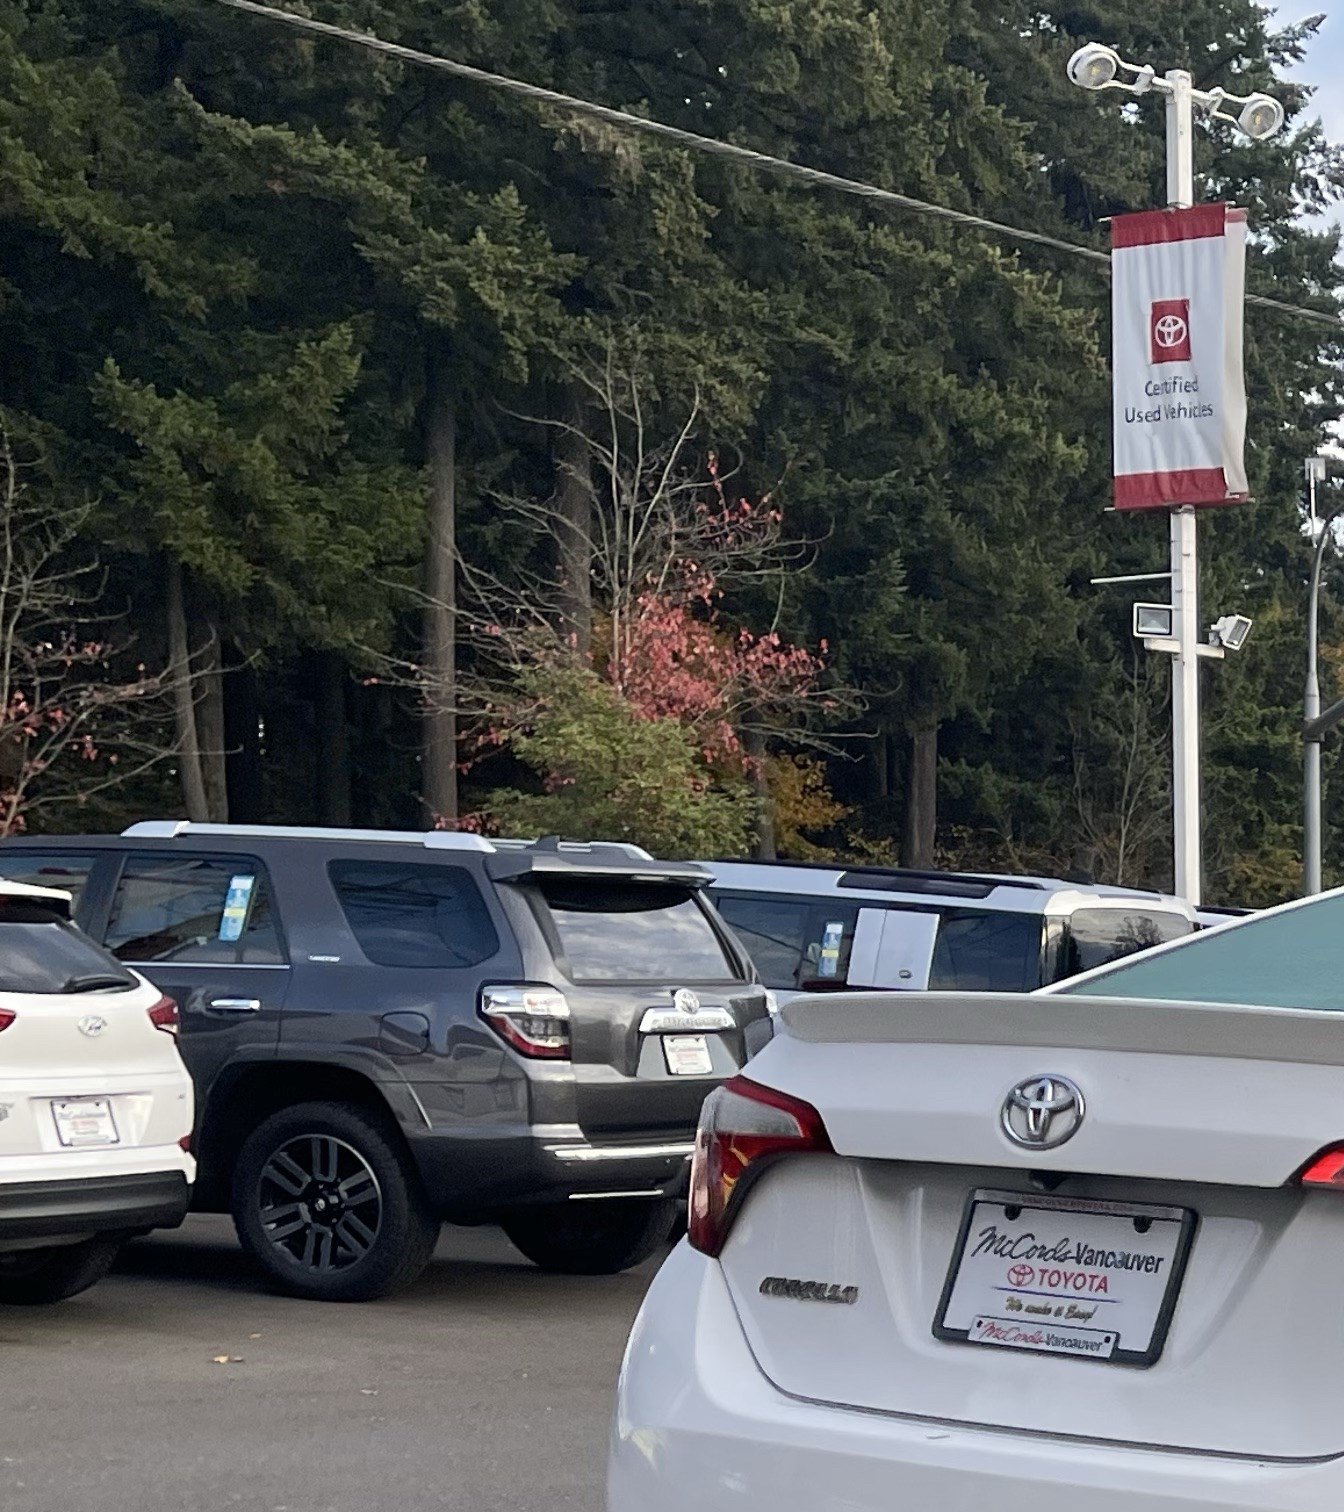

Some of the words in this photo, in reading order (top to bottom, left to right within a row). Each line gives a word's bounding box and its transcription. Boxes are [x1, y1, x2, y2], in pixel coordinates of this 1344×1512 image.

[1144, 376, 1199, 397] Certified
[1124, 404, 1161, 424] Used
[1163, 401, 1213, 420] Vehicles
[1076, 1242, 1165, 1274] Vancouver
[1038, 1268, 1109, 1293] TOYOTA
